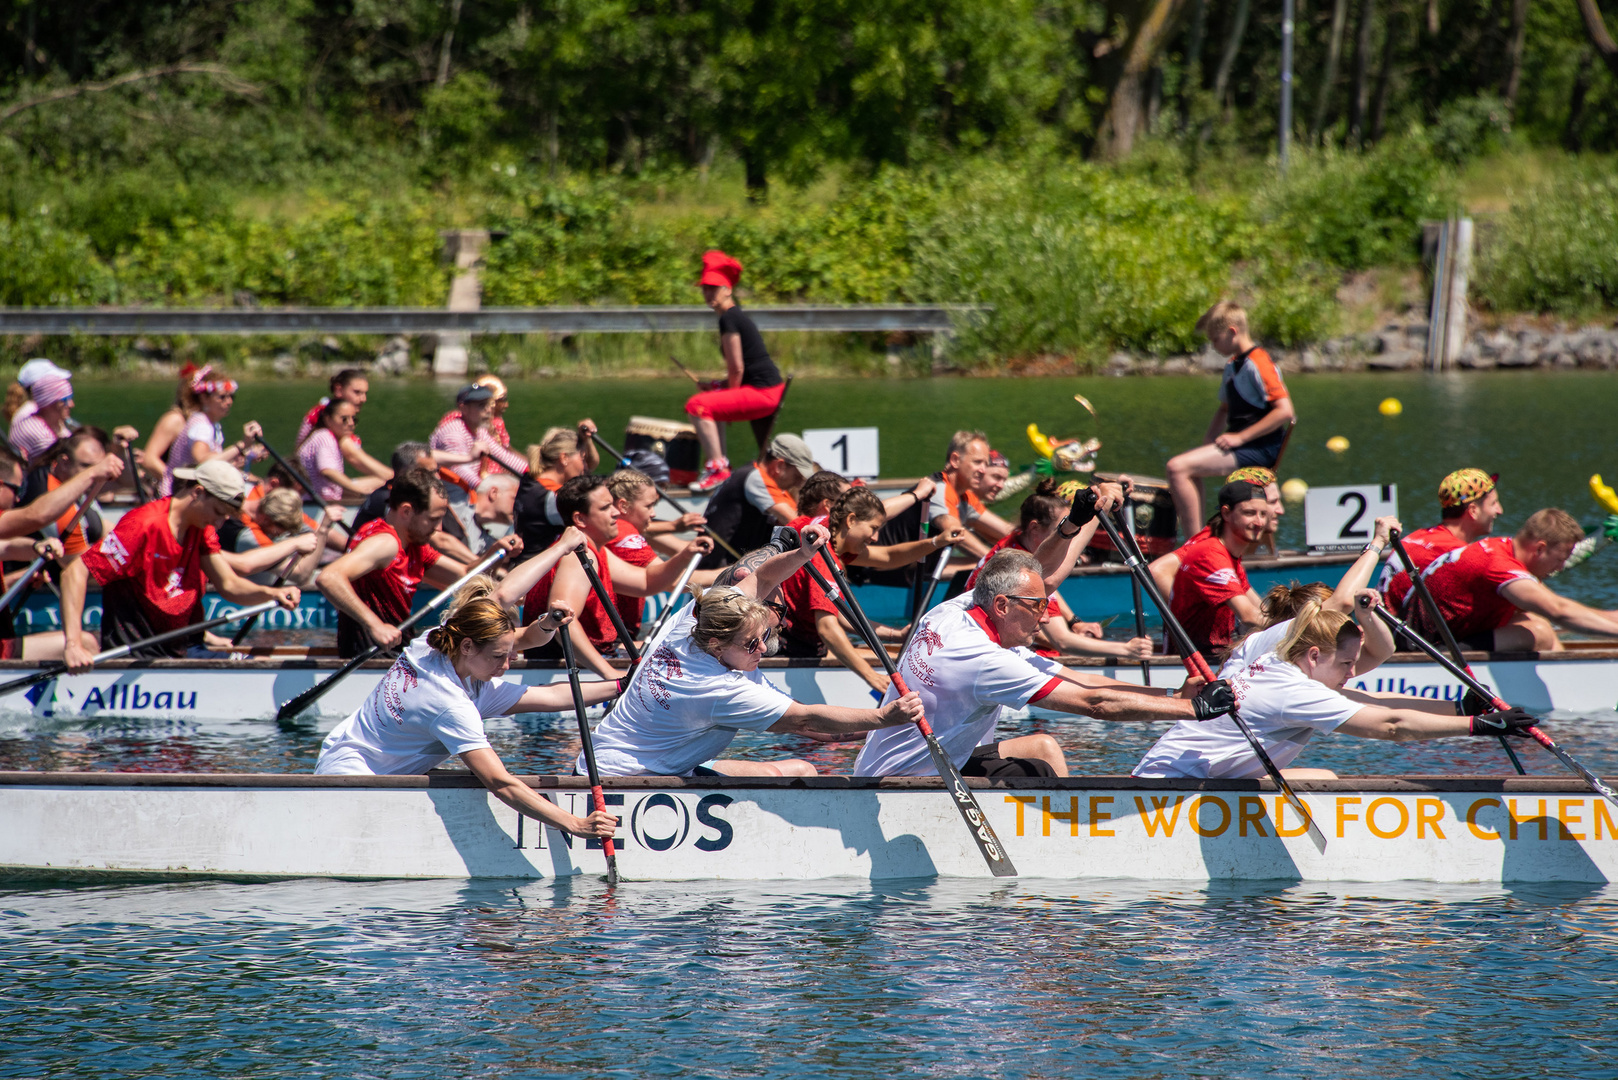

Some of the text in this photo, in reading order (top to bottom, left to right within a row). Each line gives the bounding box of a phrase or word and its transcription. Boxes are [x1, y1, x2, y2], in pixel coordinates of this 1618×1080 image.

[831, 434, 849, 472] 1
[1337, 491, 1368, 538] 2
[81, 684, 198, 710] Allbau
[390, 682, 406, 714] COLOGNE
[512, 793, 734, 851] INEOS
[965, 808, 1001, 862] GAG
[1004, 796, 1115, 837] THE
[1133, 795, 1313, 838] WORD
[1336, 796, 1447, 840] FOR
